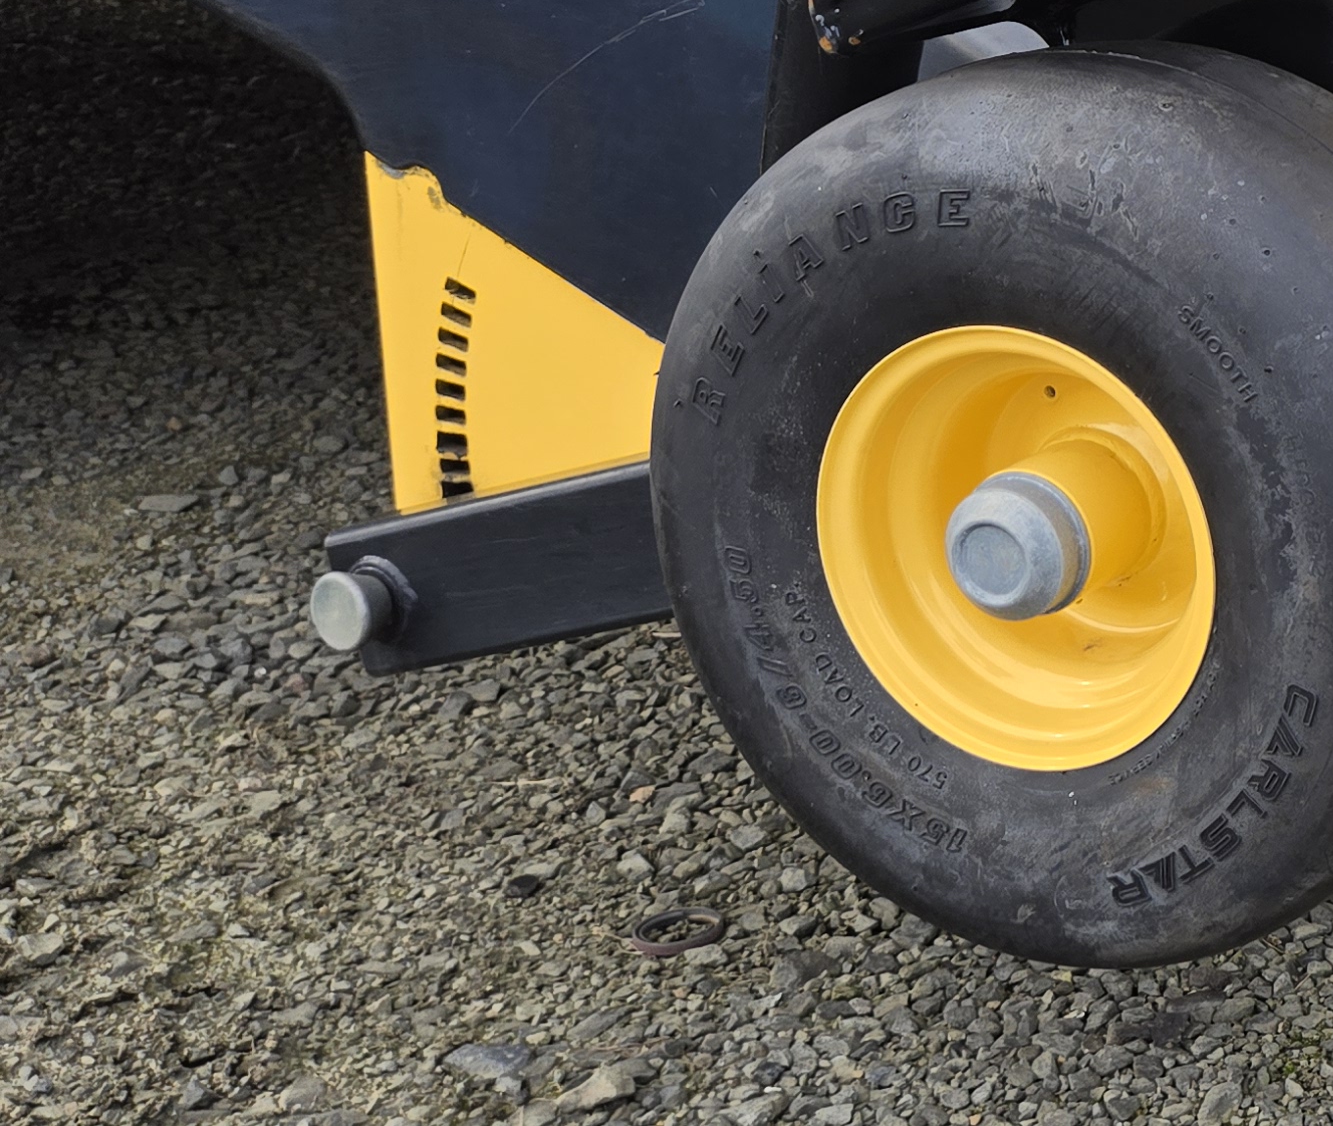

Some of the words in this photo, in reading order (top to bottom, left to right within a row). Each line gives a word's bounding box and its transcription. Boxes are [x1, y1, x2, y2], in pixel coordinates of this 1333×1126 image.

[691, 188, 971, 425] RELIANCE
[1177, 304, 1259, 403] SMOOTH
[814, 652, 865, 718] LOAD
[907, 755, 949, 790] 570
[1106, 683, 1320, 908] CARLSTAR
